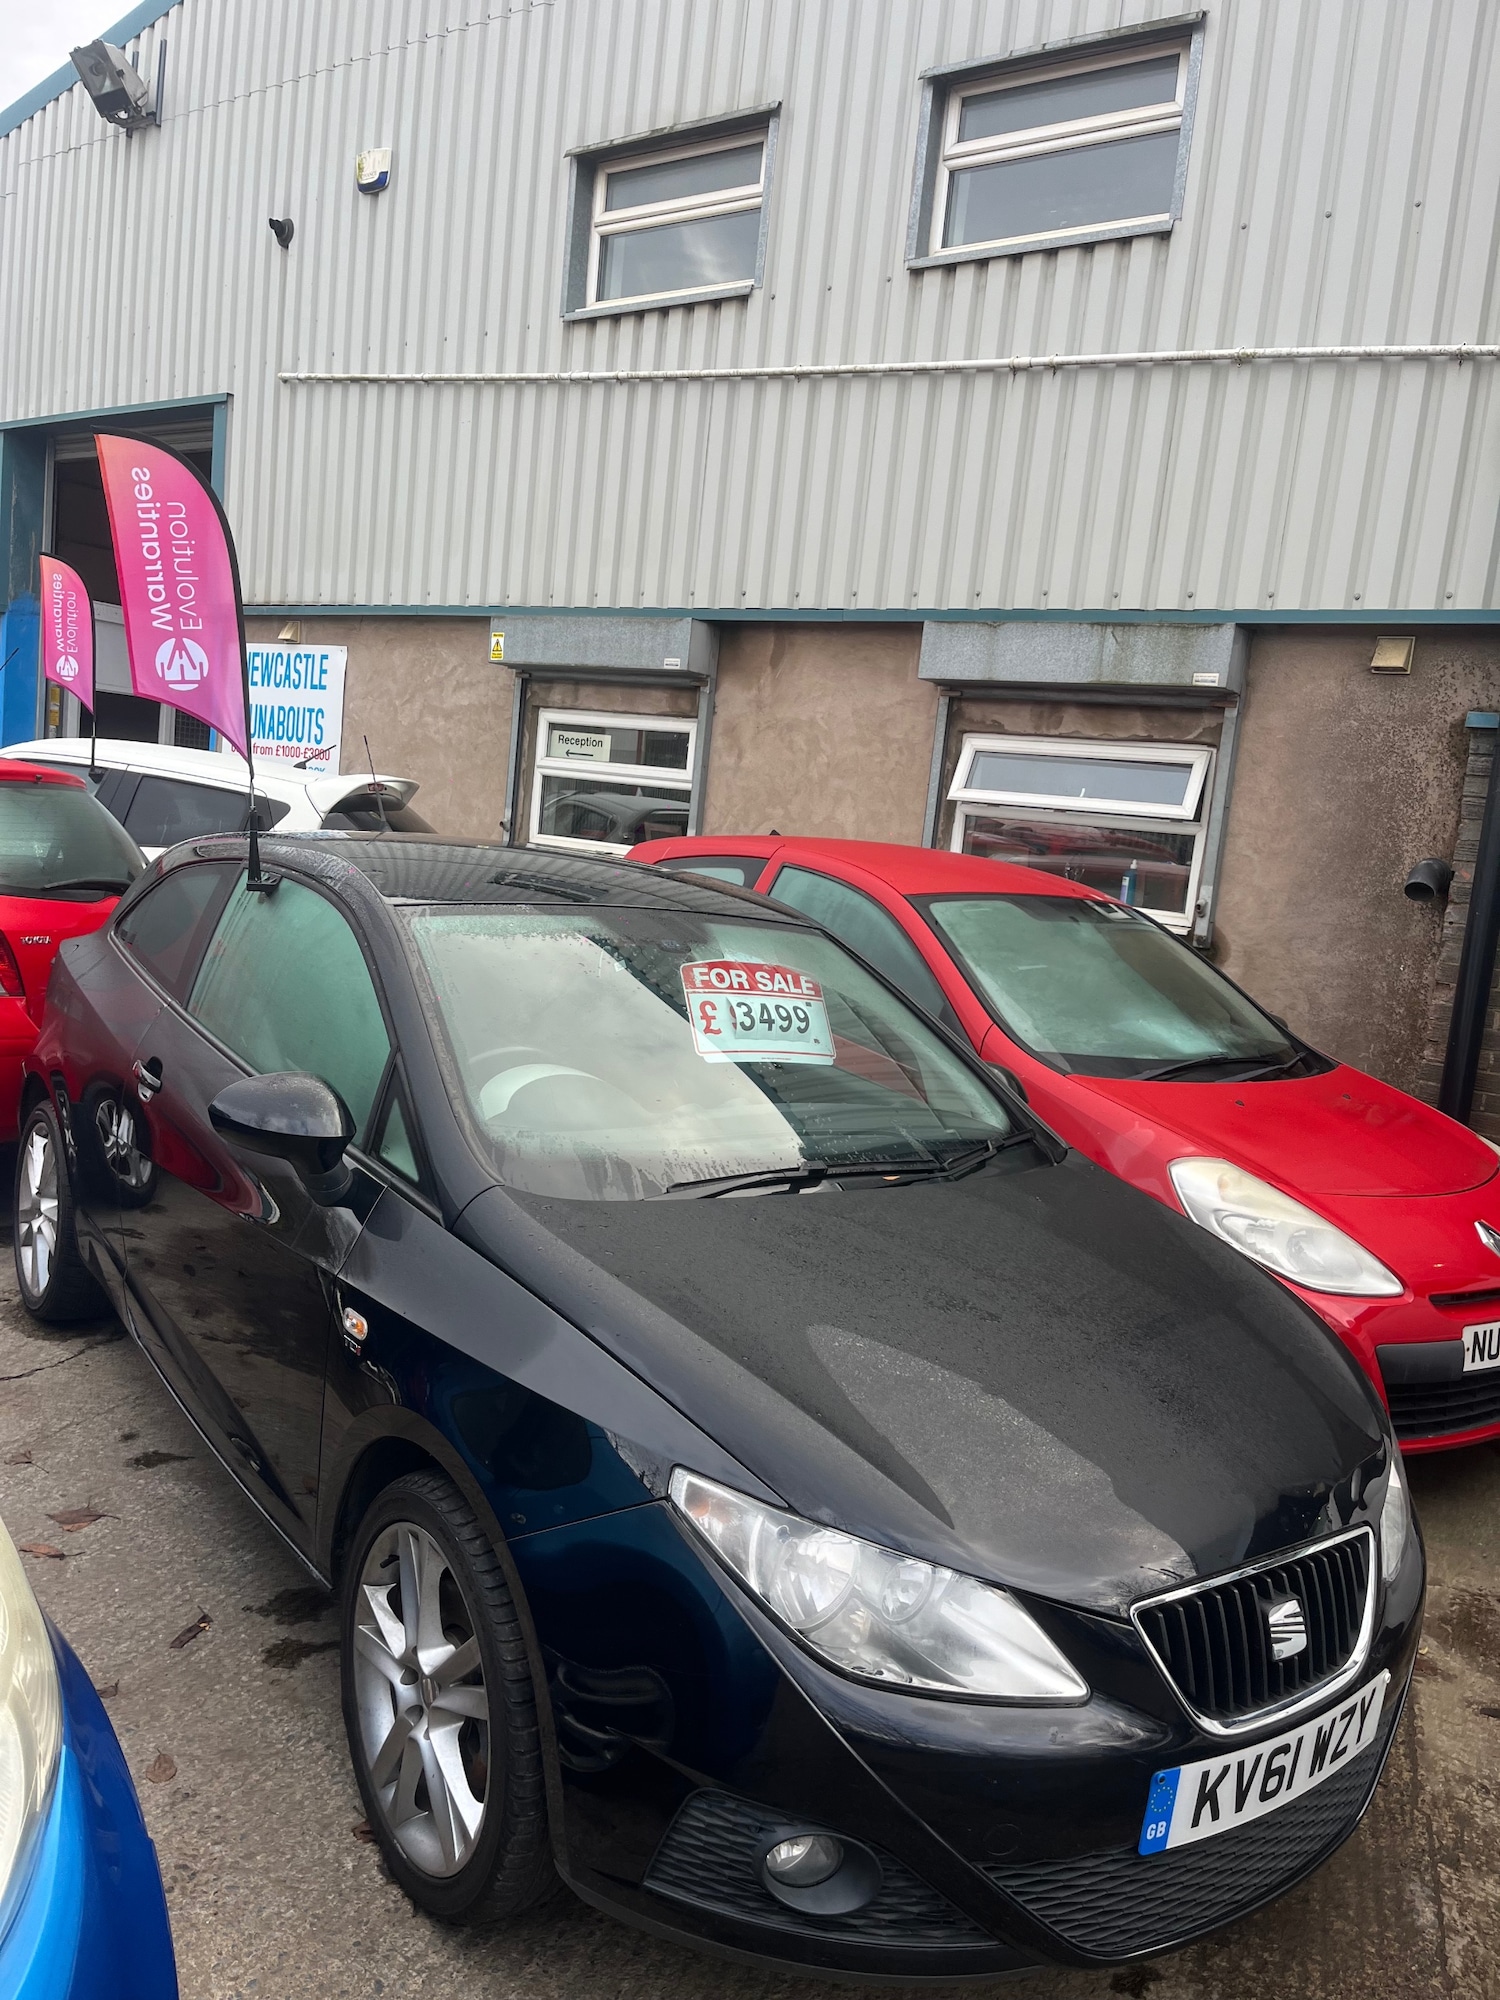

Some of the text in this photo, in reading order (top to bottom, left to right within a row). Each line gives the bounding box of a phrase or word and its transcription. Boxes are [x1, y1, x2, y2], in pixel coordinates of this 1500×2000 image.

[250, 703, 325, 745] UNABOUTS
[253, 742, 273, 756] from
[558, 734, 603, 748] Reception
[20, 935, 52, 944] TOYOTA
[692, 967, 815, 995] FOR SALE
[736, 1001, 811, 1034] 3499
[1471, 1328, 1500, 1364] NU
[1190, 1687, 1377, 1829] KV61 WZY
[1146, 1821, 1168, 1840] GB
